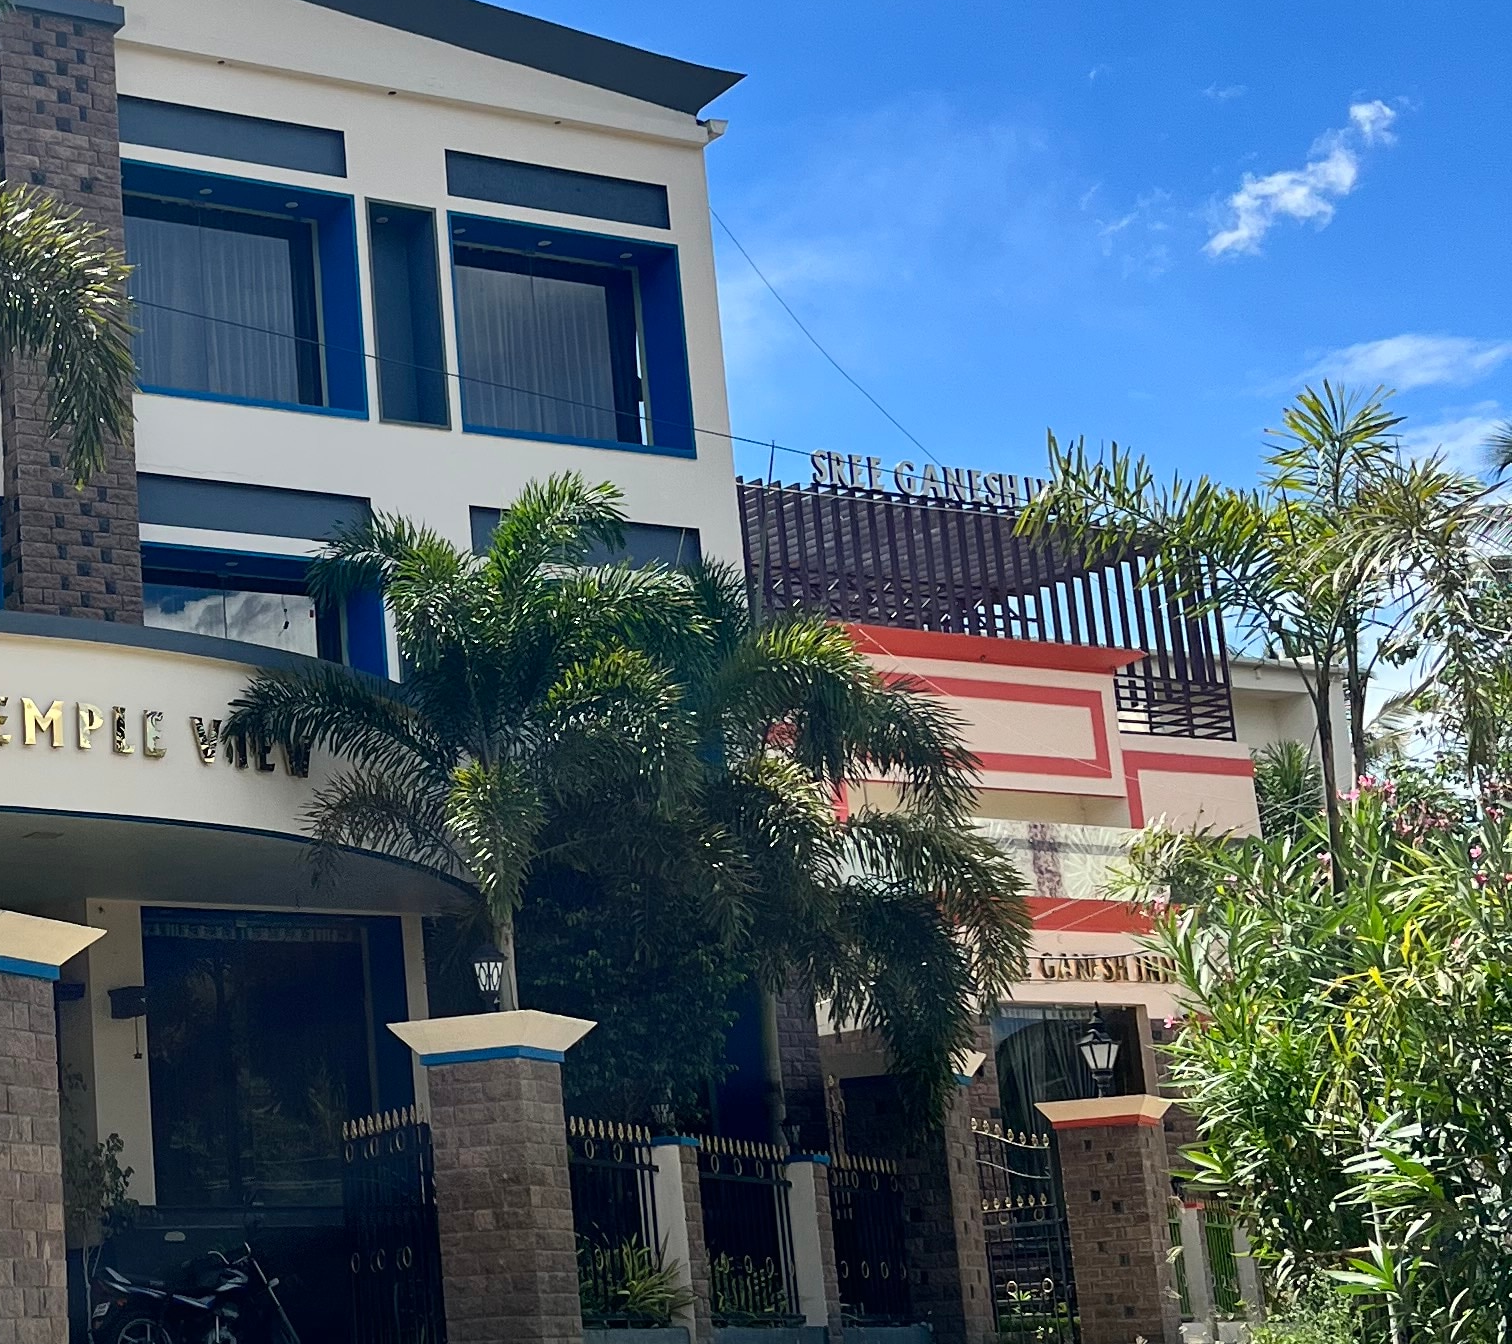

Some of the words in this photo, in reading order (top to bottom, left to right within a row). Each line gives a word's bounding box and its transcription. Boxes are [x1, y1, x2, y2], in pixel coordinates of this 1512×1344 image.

[810, 449, 885, 491] SREE
[894, 460, 1020, 508] GANESH
[1037, 952, 1129, 983] GANESH
